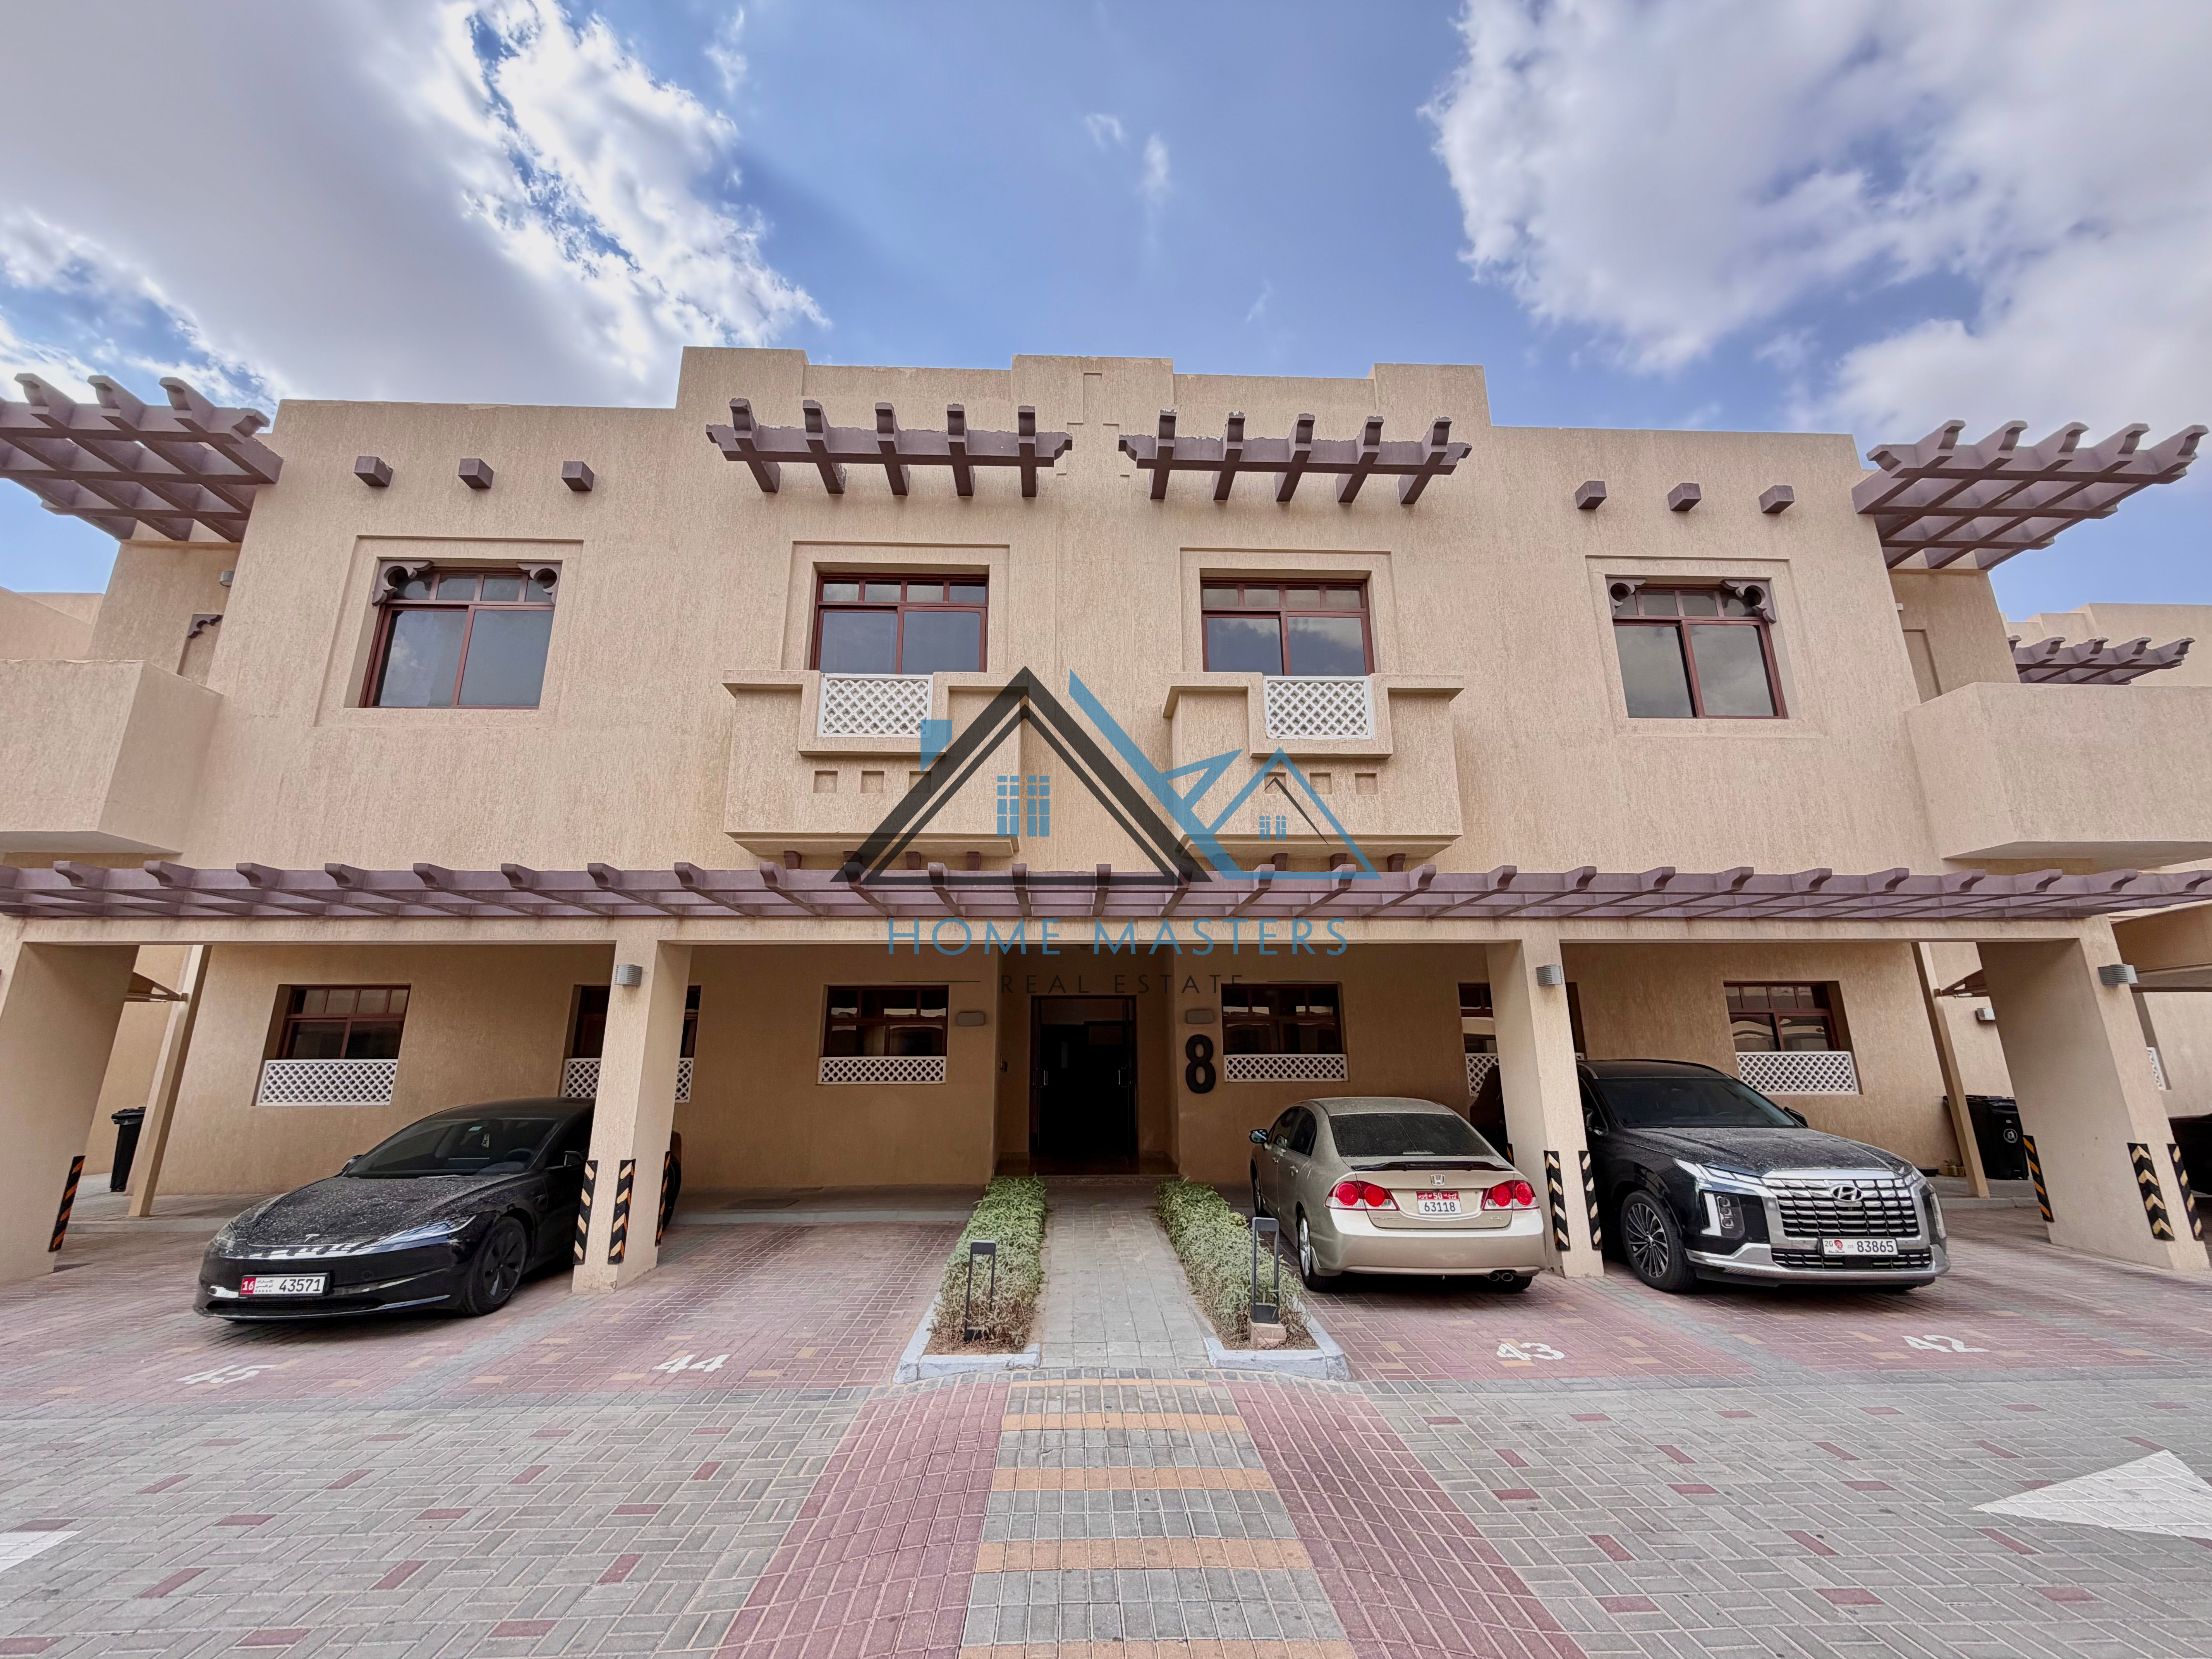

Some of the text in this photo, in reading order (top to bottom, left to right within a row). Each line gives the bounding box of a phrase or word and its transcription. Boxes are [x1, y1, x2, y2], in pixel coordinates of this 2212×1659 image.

[1185, 1034, 1216, 1094] 8
[1424, 1202, 1456, 1212] 63118
[1856, 1240, 1894, 1253] 83865
[242, 1279, 321, 1292] 16 43571
[1496, 1342, 1565, 1361] 43
[1902, 1335, 1991, 1352] 42
[652, 1354, 731, 1373] 44
[174, 1364, 279, 1384] 45
